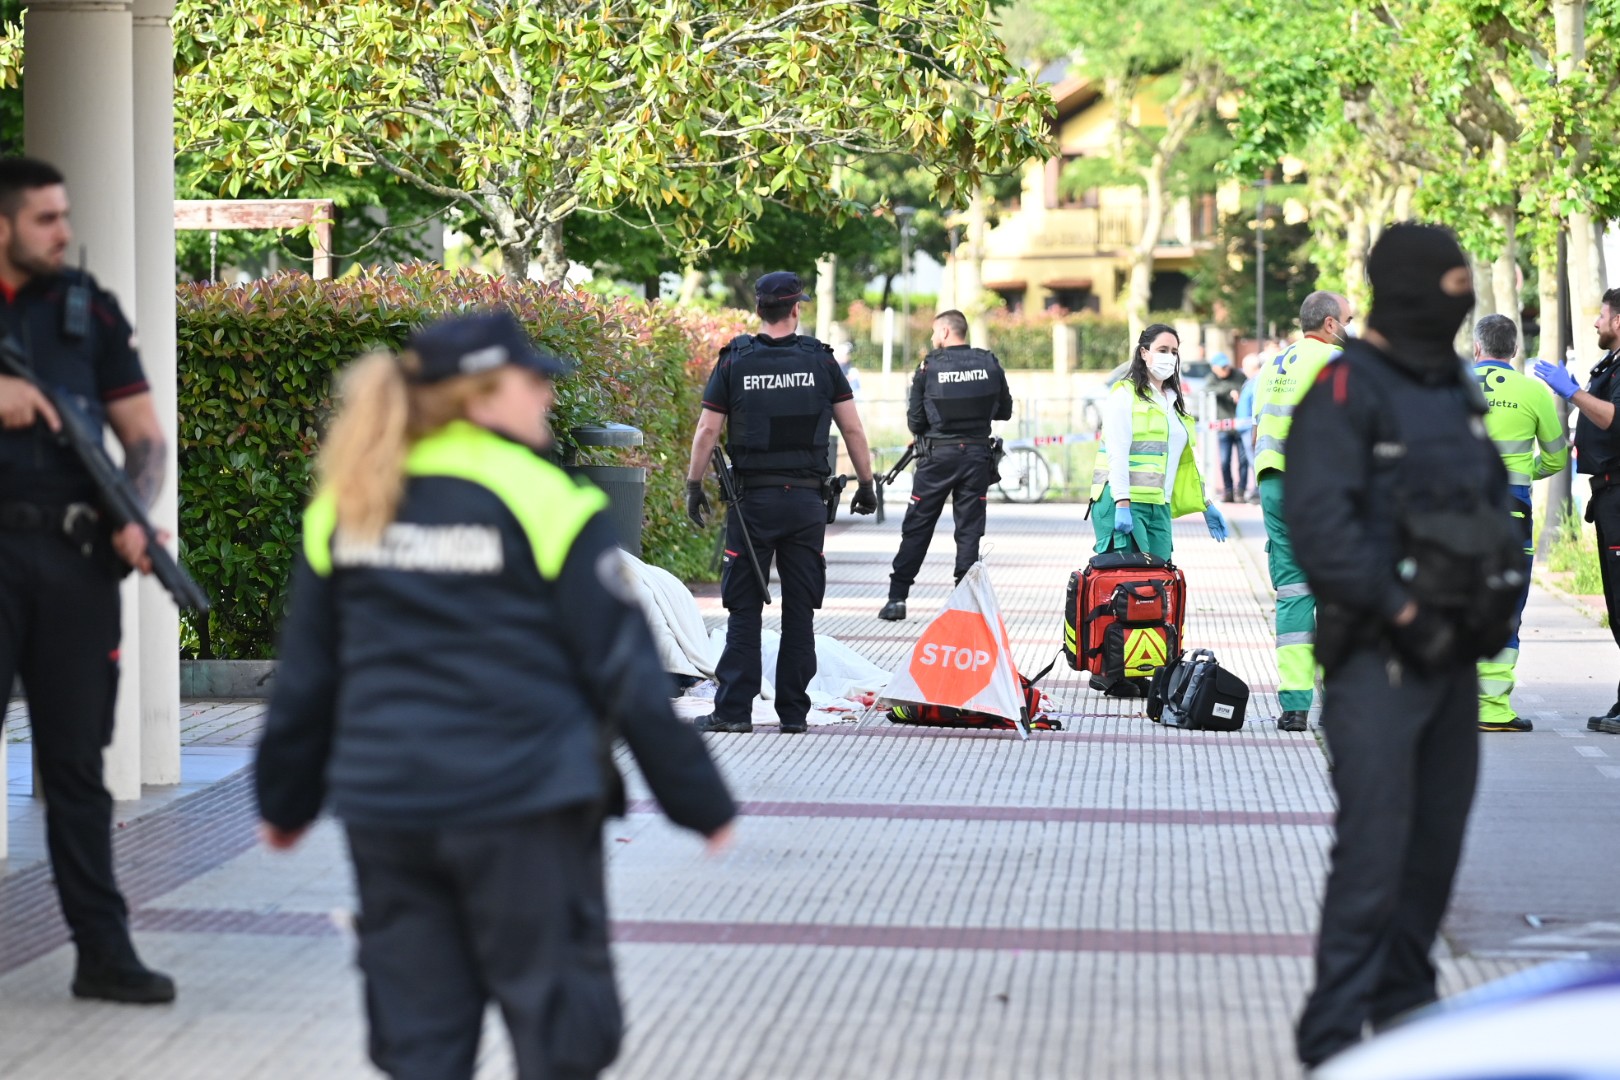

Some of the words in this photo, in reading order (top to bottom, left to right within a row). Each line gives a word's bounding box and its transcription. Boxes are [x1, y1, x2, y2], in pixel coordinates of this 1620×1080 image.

[743, 372, 815, 390] ERTZAINTZA
[938, 369, 989, 383] ERTZAINTZA
[1487, 398, 1518, 409] detza
[920, 642, 990, 671] STOP
